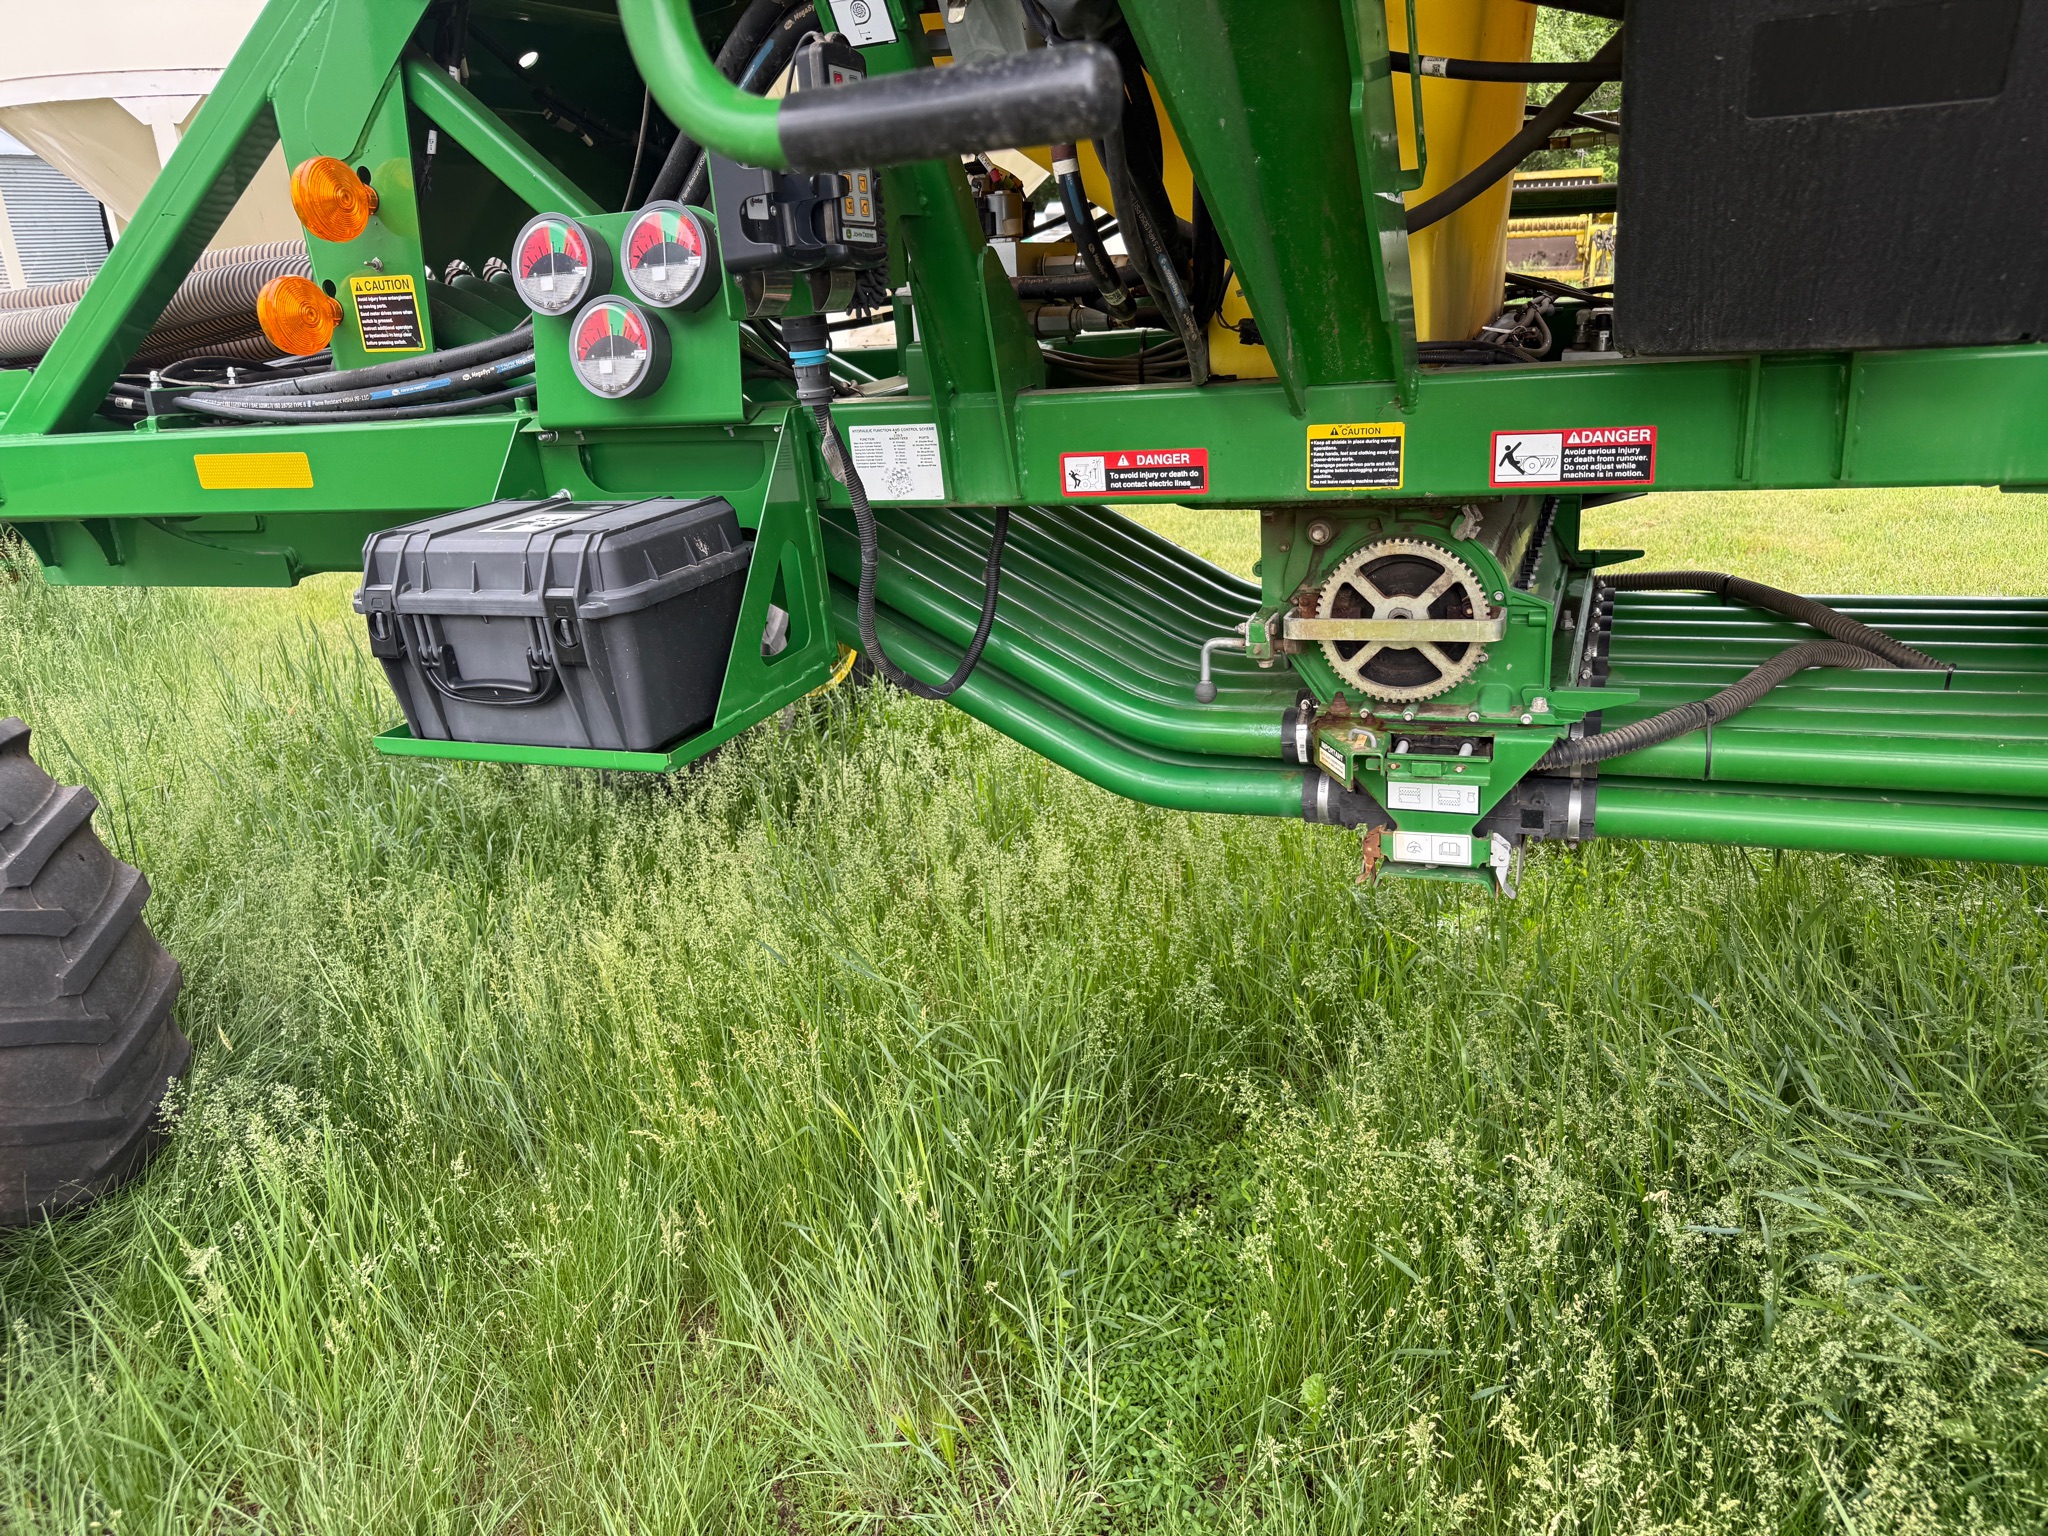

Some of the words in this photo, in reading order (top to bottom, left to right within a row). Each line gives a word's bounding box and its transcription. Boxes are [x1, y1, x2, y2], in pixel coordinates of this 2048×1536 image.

[364, 279, 409, 291] CAUTION
[1582, 430, 1650, 444] DANGER
[1618, 447, 1640, 455] injury
[1136, 454, 1190, 465] DANGER
[1590, 463, 1614, 471] adjust
[1140, 471, 1158, 480] injury
